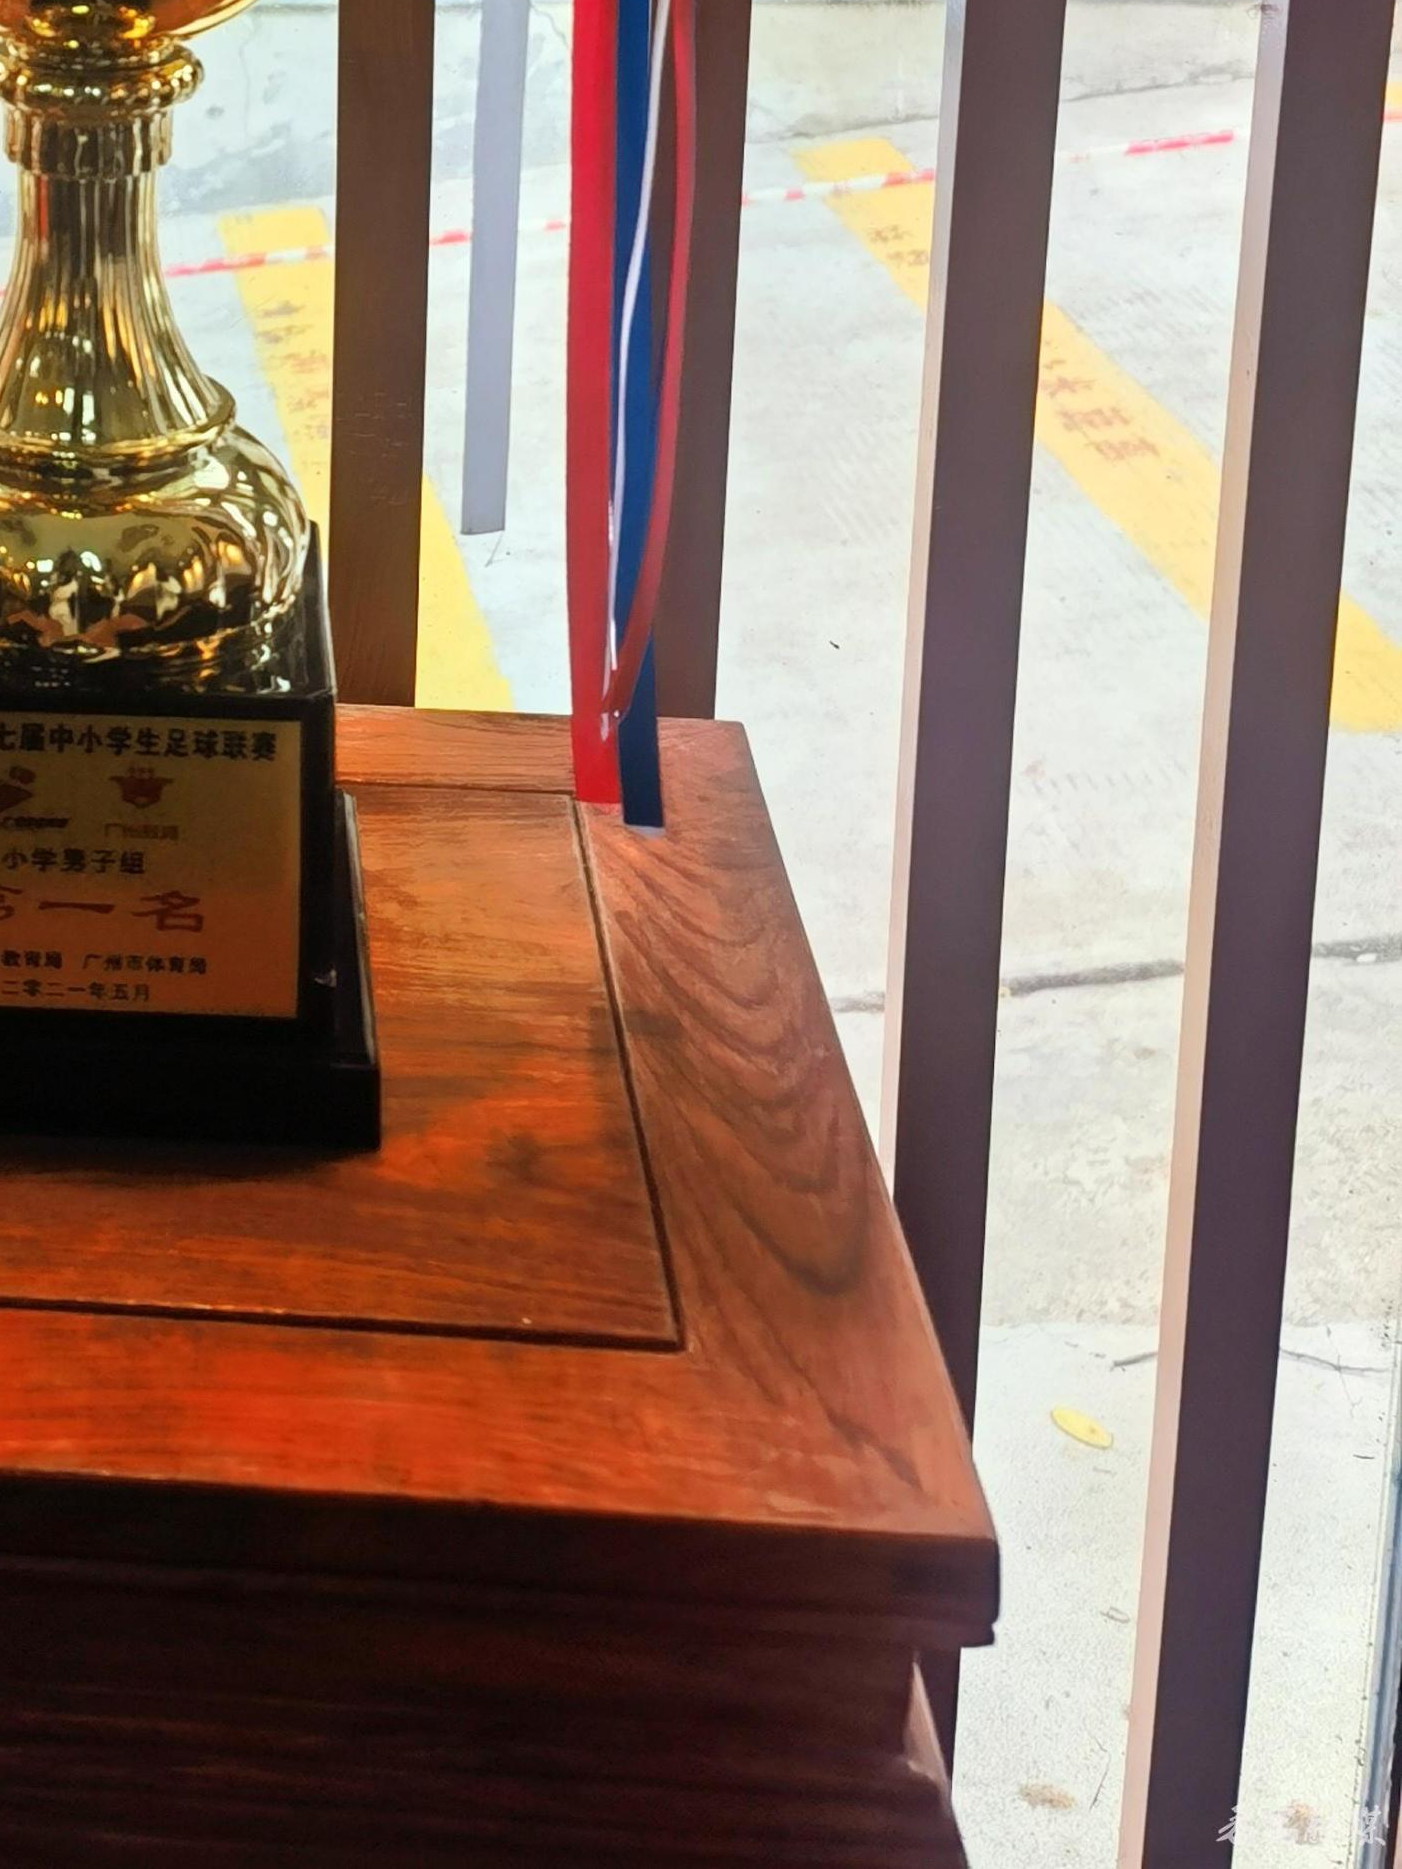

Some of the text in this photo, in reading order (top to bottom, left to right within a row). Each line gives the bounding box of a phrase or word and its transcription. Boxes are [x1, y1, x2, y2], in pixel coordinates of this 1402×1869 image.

[1, 847, 146, 875] 小学男子组
[82, 952, 208, 975] 广州市体育局
[1, 979, 151, 1003] 二零二一年五月
